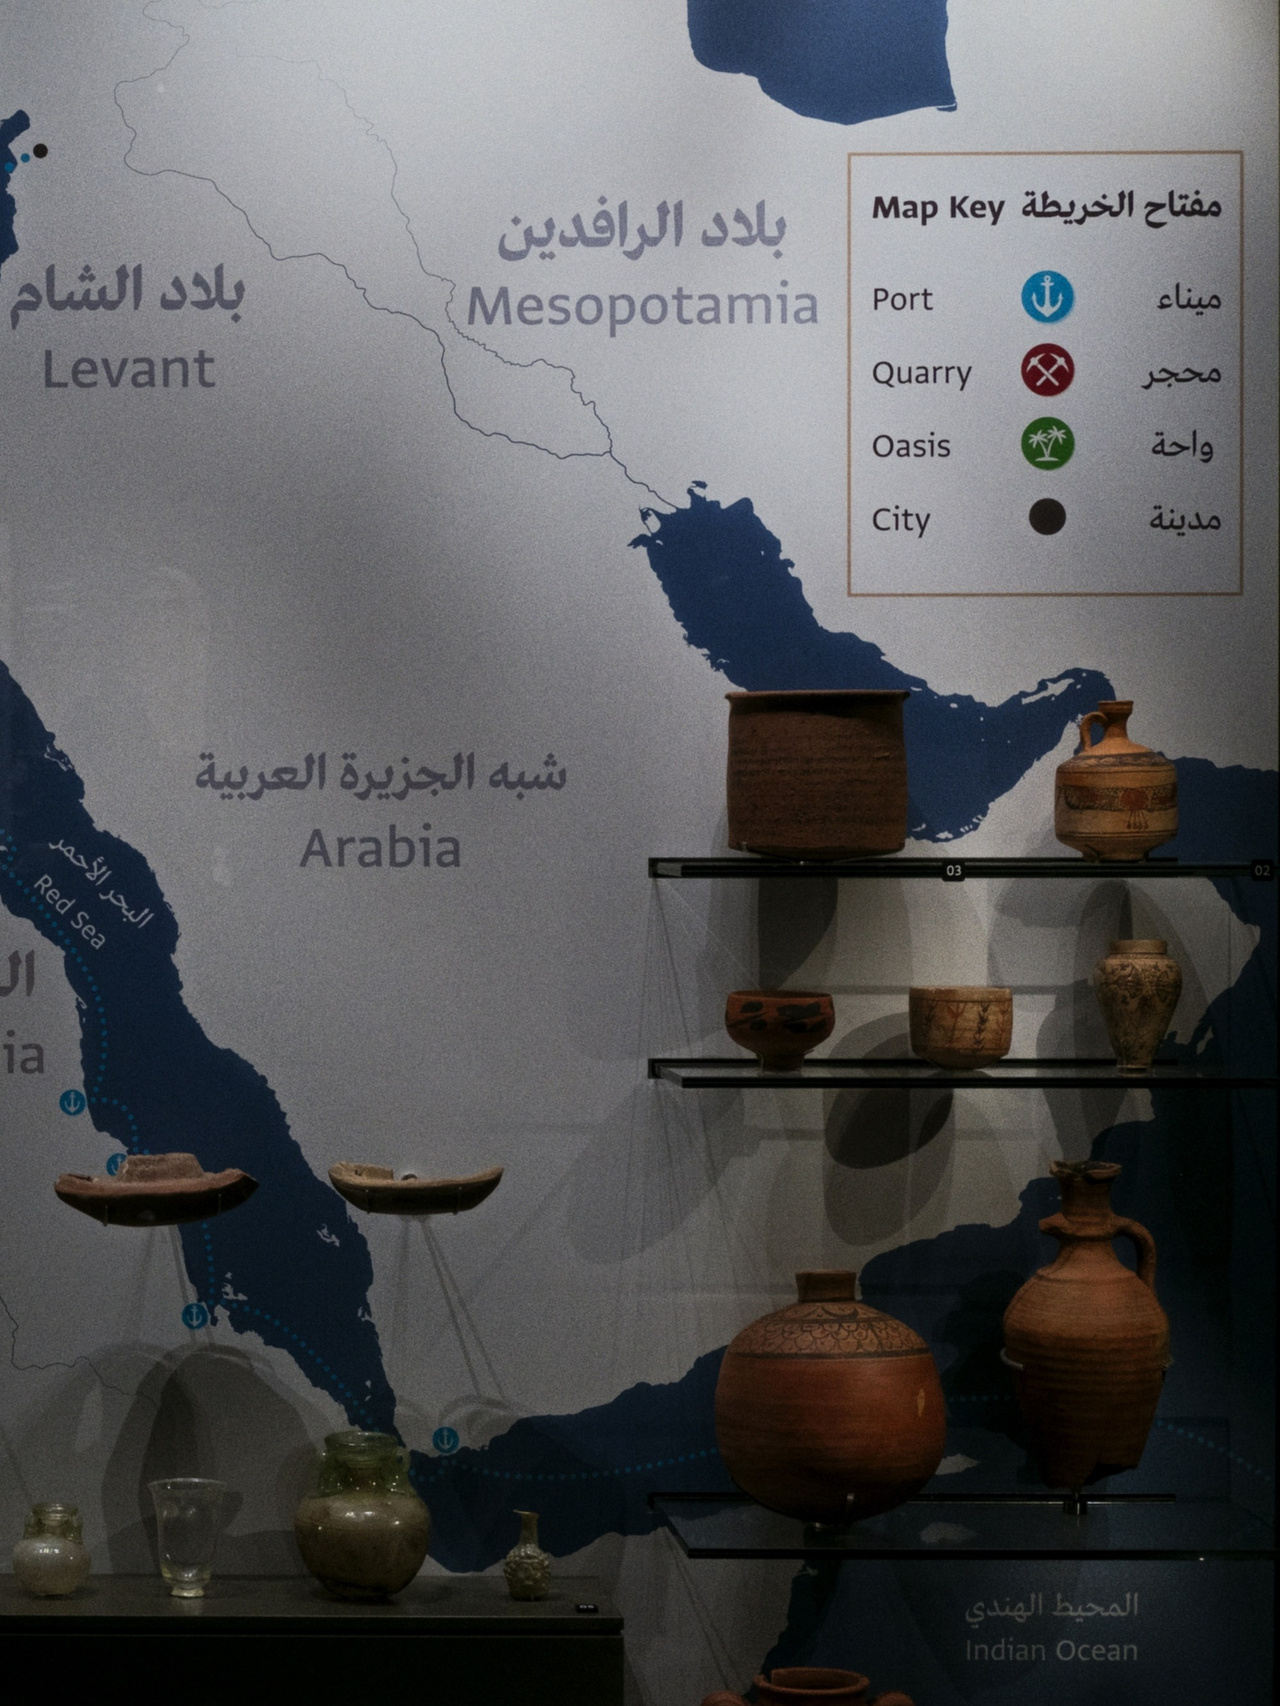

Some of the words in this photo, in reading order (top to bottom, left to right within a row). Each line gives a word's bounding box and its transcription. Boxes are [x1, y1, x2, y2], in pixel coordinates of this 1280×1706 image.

[873, 196, 938, 226] Map
[951, 196, 1005, 225] Key
[1022, 190, 1134, 225] الخريطة
[1145, 191, 1222, 228] مفتاح
[498, 196, 683, 261] الرافدين
[701, 200, 786, 259] بلاد
[10, 264, 142, 330] الشام
[160, 264, 245, 323] بلاد
[467, 281, 819, 338] Mesopotamia
[874, 288, 933, 311] Port
[1158, 283, 1222, 316] ميناء
[44, 350, 215, 388] Levant
[873, 361, 972, 391] Quarry
[1142, 367, 1222, 390] محجر
[873, 432, 951, 458] Oasis
[1152, 430, 1214, 463] واحة
[873, 505, 930, 538] City
[1150, 505, 1221, 536] مدينة
[196, 752, 326, 800] العربية
[341, 752, 474, 800] الجزيرة
[489, 753, 566, 799] شبه
[48, 839, 112, 886] الأحمر
[300, 825, 460, 868] Arabia
[946, 864, 962, 876] 03
[1254, 864, 1271, 876] 02
[33, 873, 76, 915] Red
[70, 911, 106, 950] Sea
[98, 889, 155, 929] البحر
[966, 1592, 1043, 1628] الهندي
[1054, 1592, 1138, 1623] المحيط
[967, 1637, 1046, 1661] Indian
[1056, 1639, 1137, 1661] Ocean
